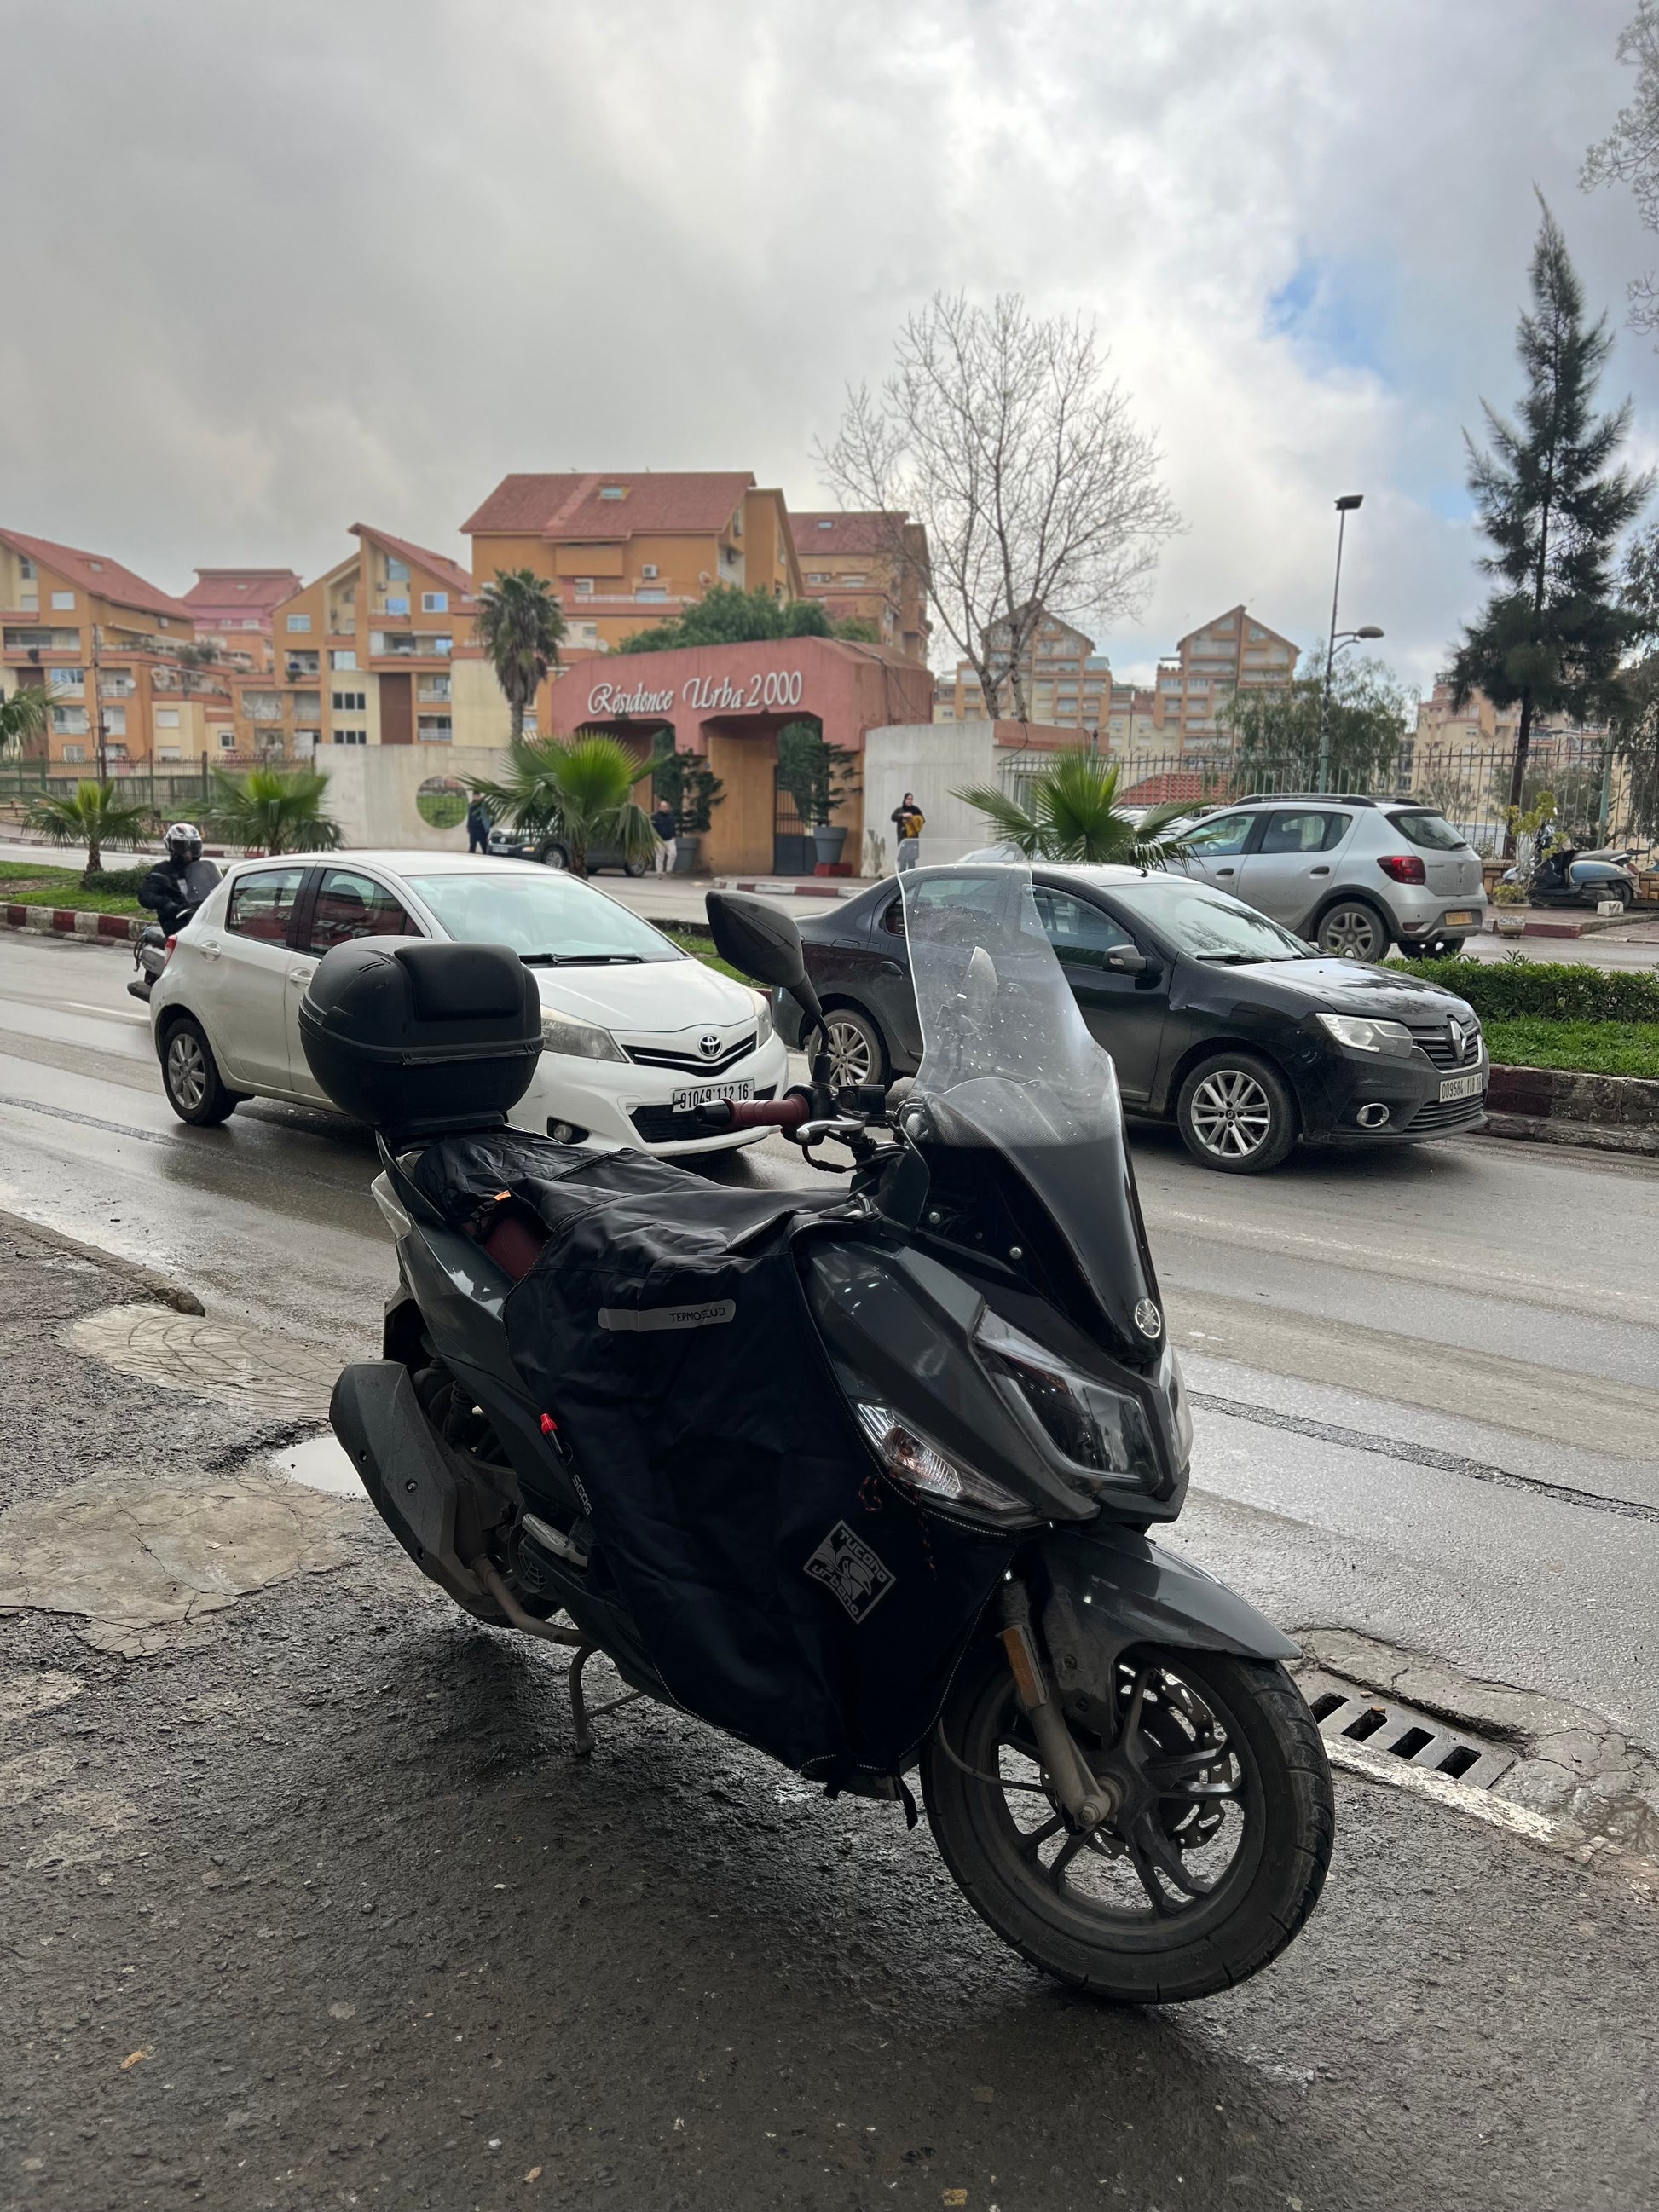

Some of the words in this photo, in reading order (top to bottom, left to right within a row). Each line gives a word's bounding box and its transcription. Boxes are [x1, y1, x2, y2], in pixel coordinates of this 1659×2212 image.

[587, 682, 675, 714] Résidence
[683, 676, 745, 709] Urba
[746, 671, 802, 708] 2000
[679, 1089, 712, 1109] 91049
[737, 1083, 749, 1100] 16
